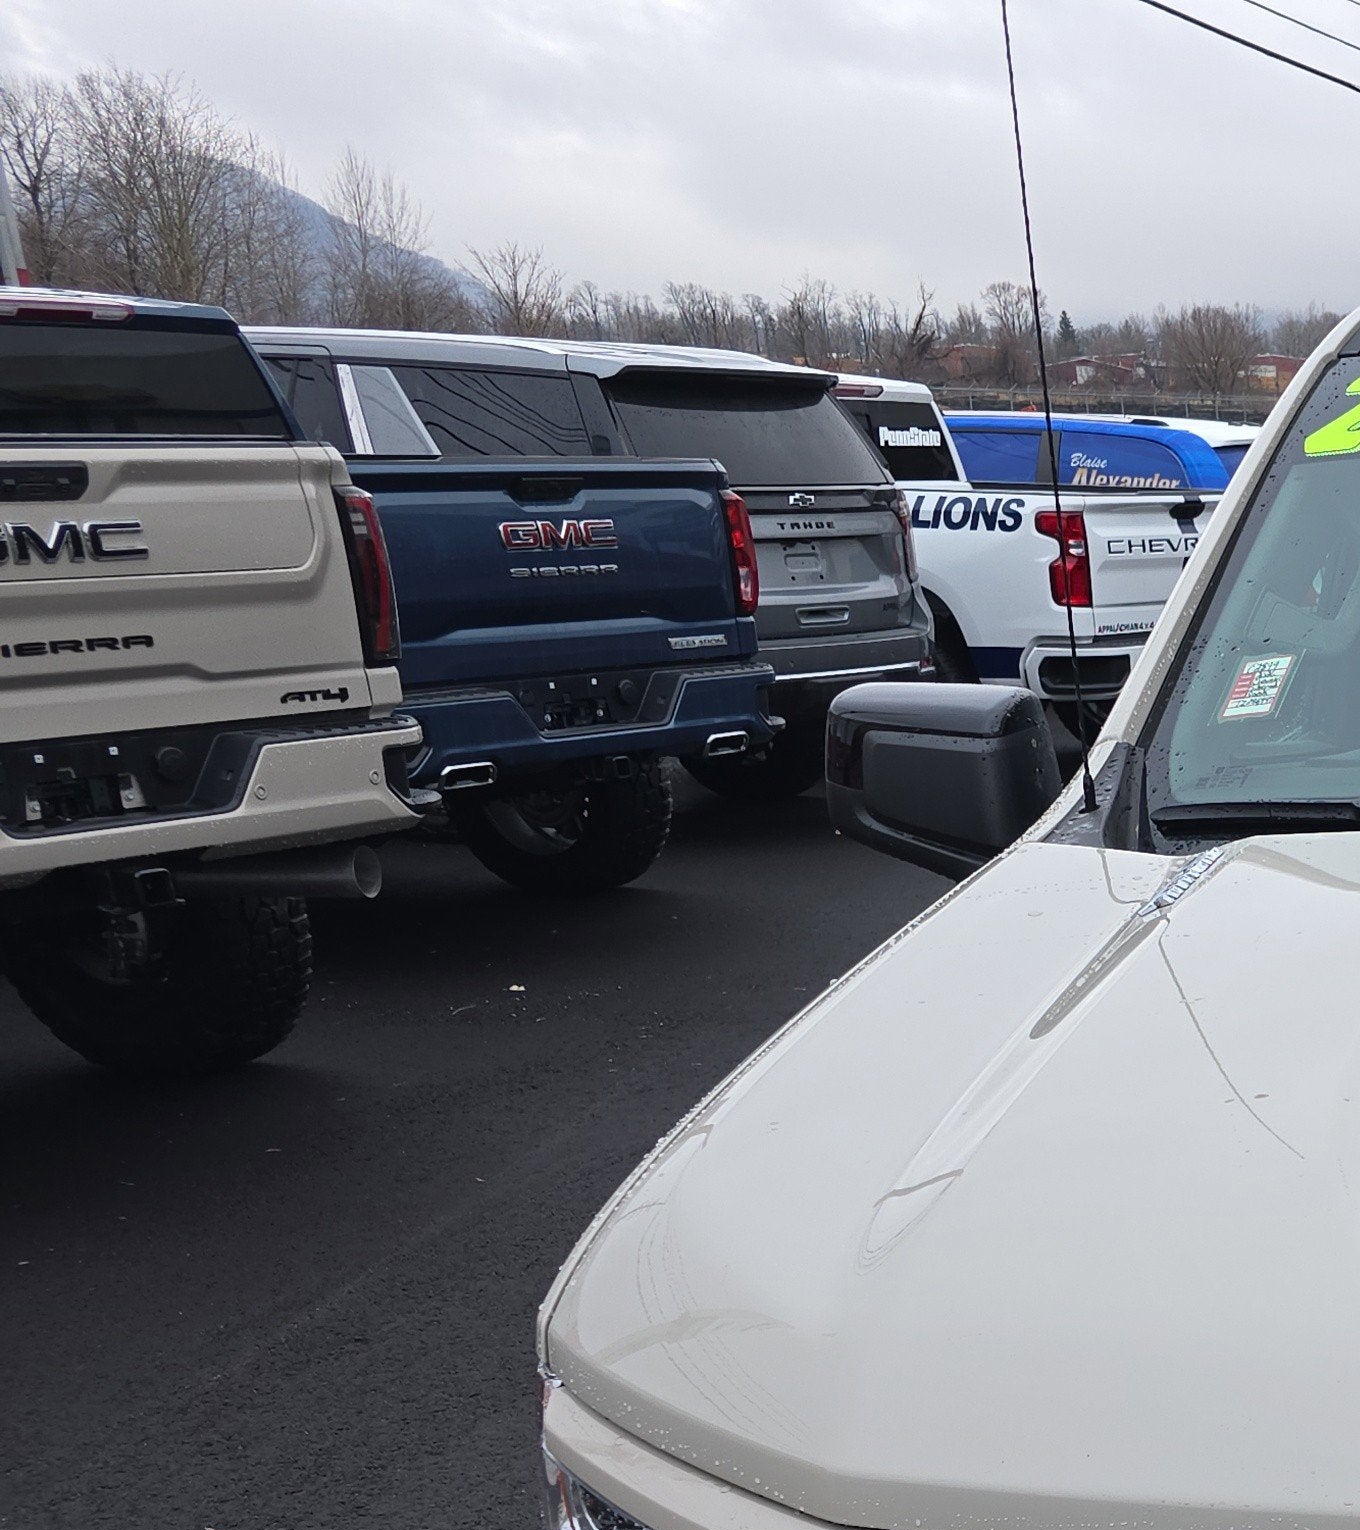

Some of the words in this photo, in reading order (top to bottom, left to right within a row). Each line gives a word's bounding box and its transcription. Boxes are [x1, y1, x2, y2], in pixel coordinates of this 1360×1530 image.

[1070, 452, 1107, 468] Blaise
[1071, 467, 1180, 489] Alexander
[911, 495, 1025, 532] LIONS
[499, 519, 618, 551] GMC
[776, 521, 836, 531] TAHOE
[0, 520, 149, 565] MC
[1107, 537, 1199, 555] CHEVR
[510, 564, 618, 577] SIERRA
[1, 635, 154, 657] IERRA
[280, 687, 349, 704] AT4
